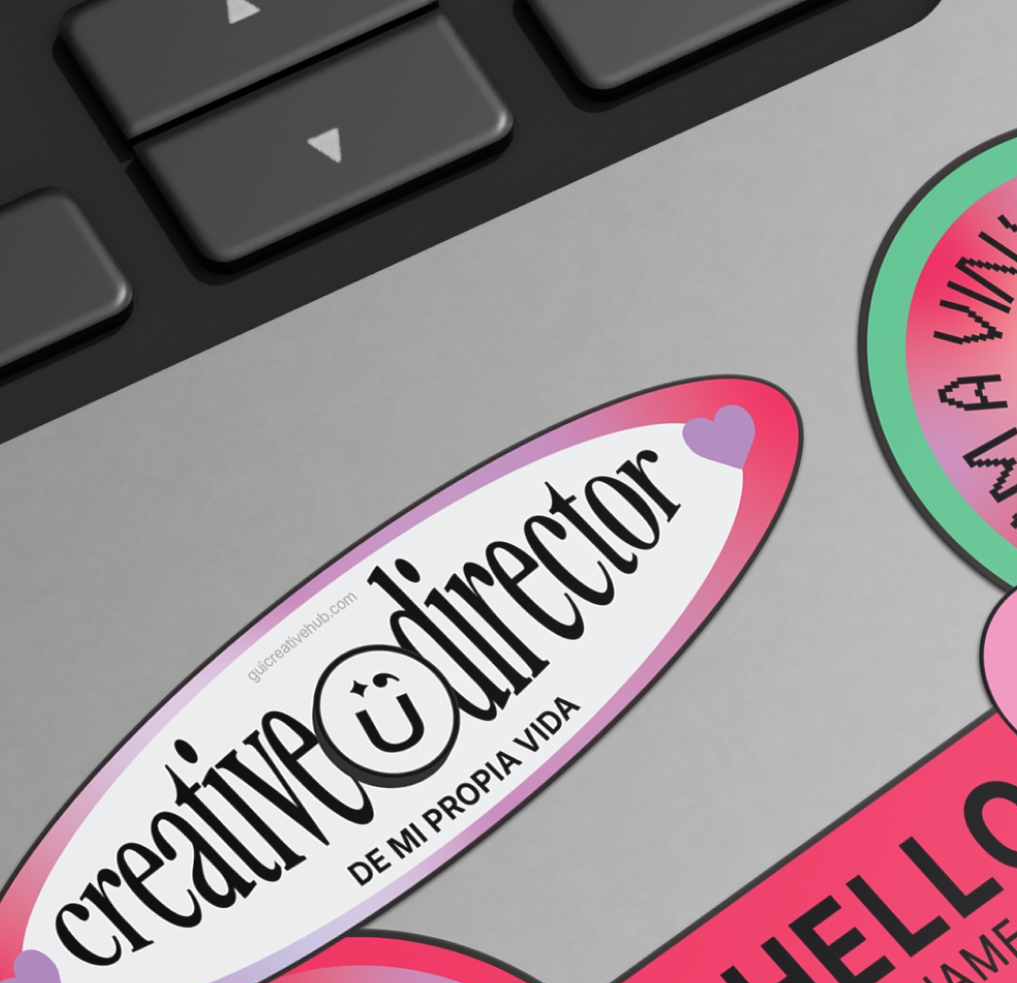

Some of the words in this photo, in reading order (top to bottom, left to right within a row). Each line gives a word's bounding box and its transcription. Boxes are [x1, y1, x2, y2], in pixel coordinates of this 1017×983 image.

[937, 373, 1009, 412] A
[55, 738, 375, 967] creative
[366, 447, 682, 722] director
[247, 590, 358, 684] guicreativehub.com
[346, 846, 392, 887] DE
[386, 822, 429, 860] MI
[421, 750, 523, 833] PROPIA
[512, 694, 582, 753] VIDA
